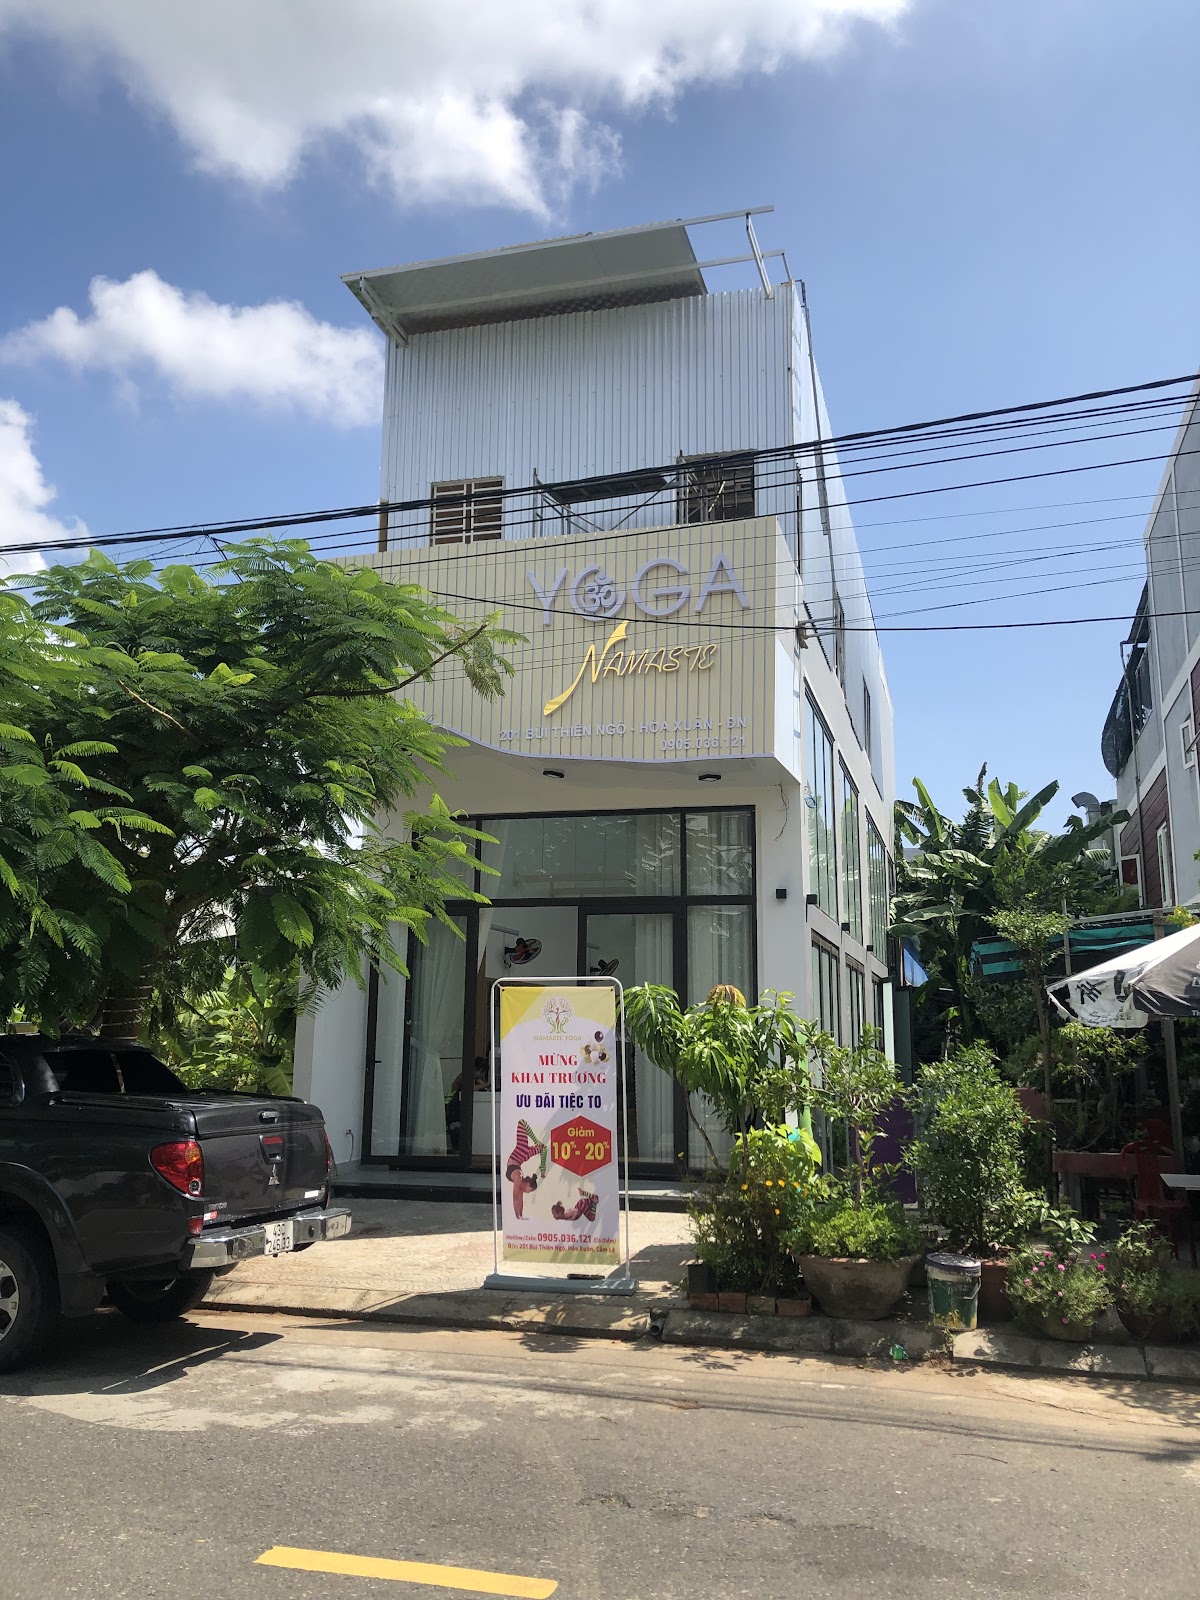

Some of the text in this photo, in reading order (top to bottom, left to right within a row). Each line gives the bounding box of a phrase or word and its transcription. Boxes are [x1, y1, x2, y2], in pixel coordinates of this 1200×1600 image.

[527, 553, 750, 626] YOGA
[499, 729, 521, 741] 201
[525, 725, 548, 740] BÙI
[551, 724, 592, 740] THIỆN
[596, 719, 628, 737] NGỘ
[639, 719, 669, 734] HÒA
[673, 716, 714, 732] XUÂN
[726, 715, 747, 729] ĐN
[660, 735, 746, 751] 0905.036.121
[538, 1052, 578, 1066] MỪNG
[511, 1070, 607, 1084] KHAI TRƯƠNG
[516, 1092, 602, 1111] ƯU ĐÃI TIỆC TO
[567, 1126, 595, 1137] Giảm
[537, 1233, 592, 1243] 0905.036.121
